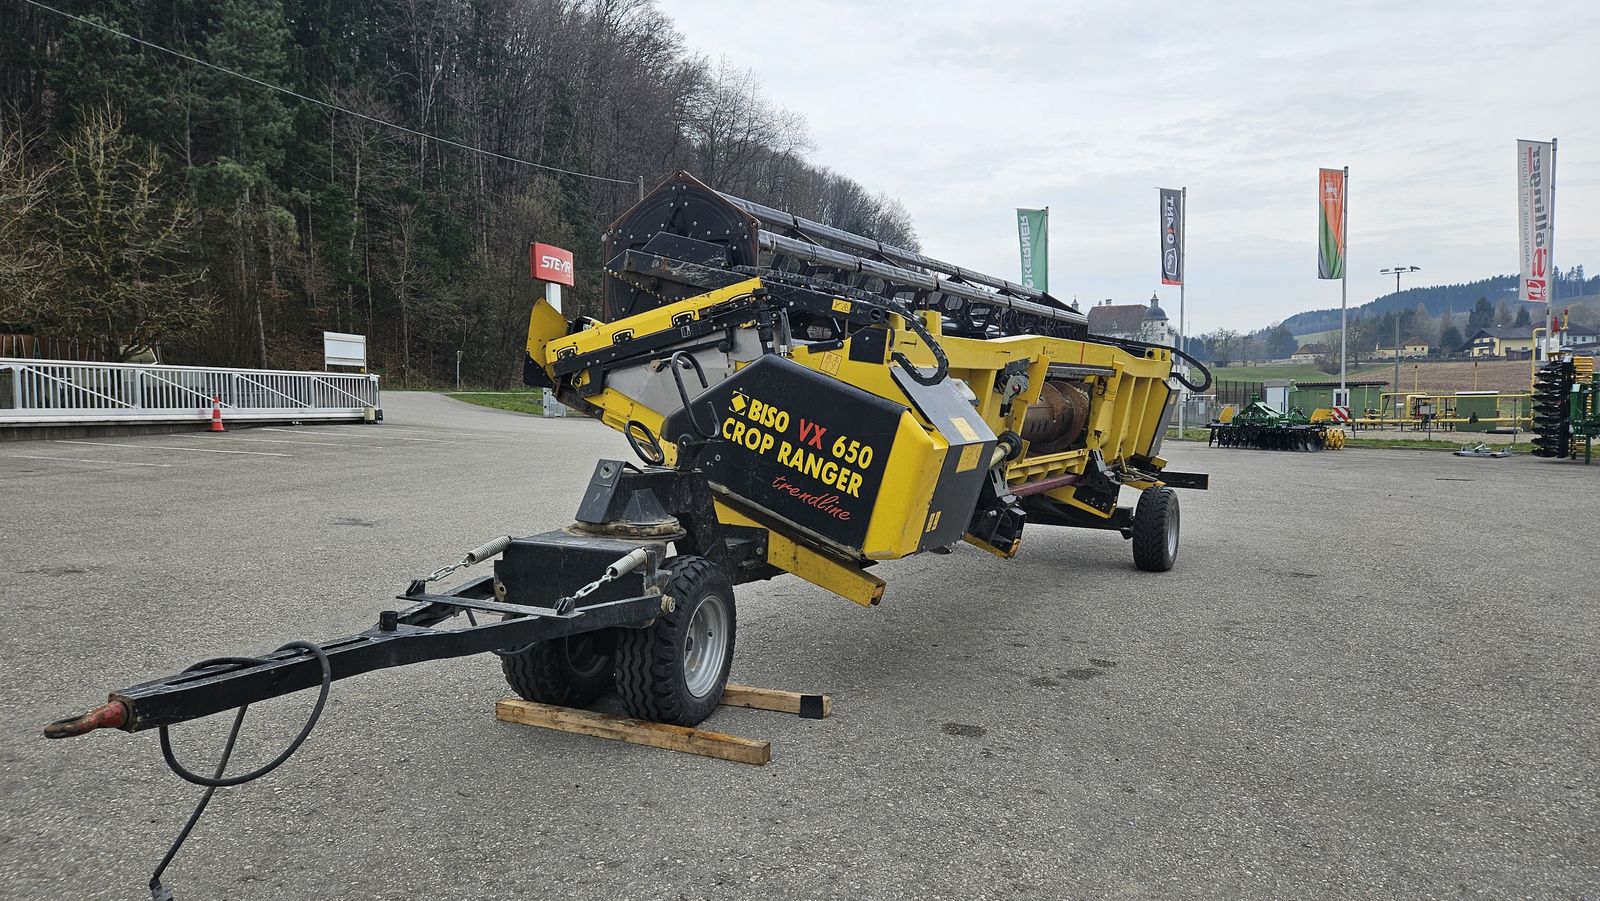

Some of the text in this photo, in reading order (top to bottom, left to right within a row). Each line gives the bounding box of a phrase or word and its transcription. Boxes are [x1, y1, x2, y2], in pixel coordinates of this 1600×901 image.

[541, 255, 571, 273] STEYR
[722, 417, 863, 498] CROP RANGER
[748, 399, 874, 470] BISO VX 650
[772, 476, 850, 520] trendline
